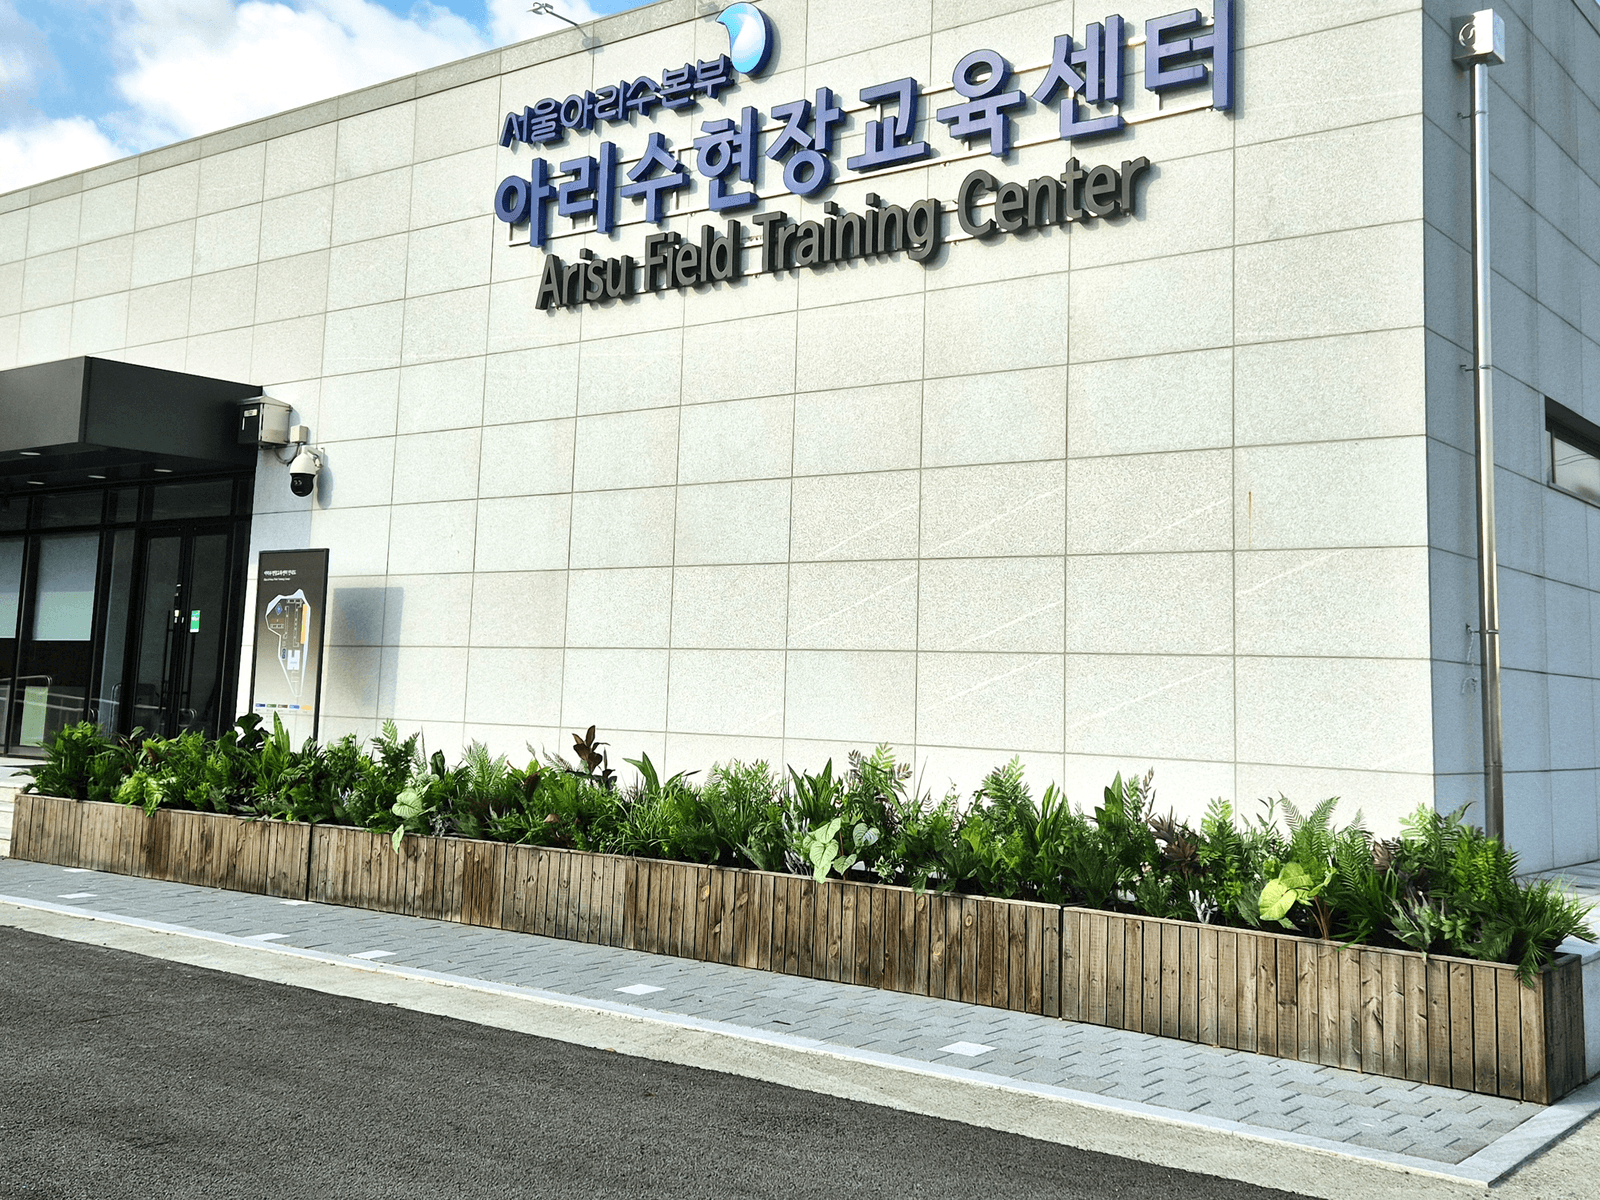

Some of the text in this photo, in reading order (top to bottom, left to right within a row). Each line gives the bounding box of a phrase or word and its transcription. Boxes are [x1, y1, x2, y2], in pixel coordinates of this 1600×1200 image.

[494, 0, 1235, 248] 아리수현장교육센터
[499, 53, 734, 148] 서울아리수본부
[535, 156, 1151, 311] Arisu Field Training Center
